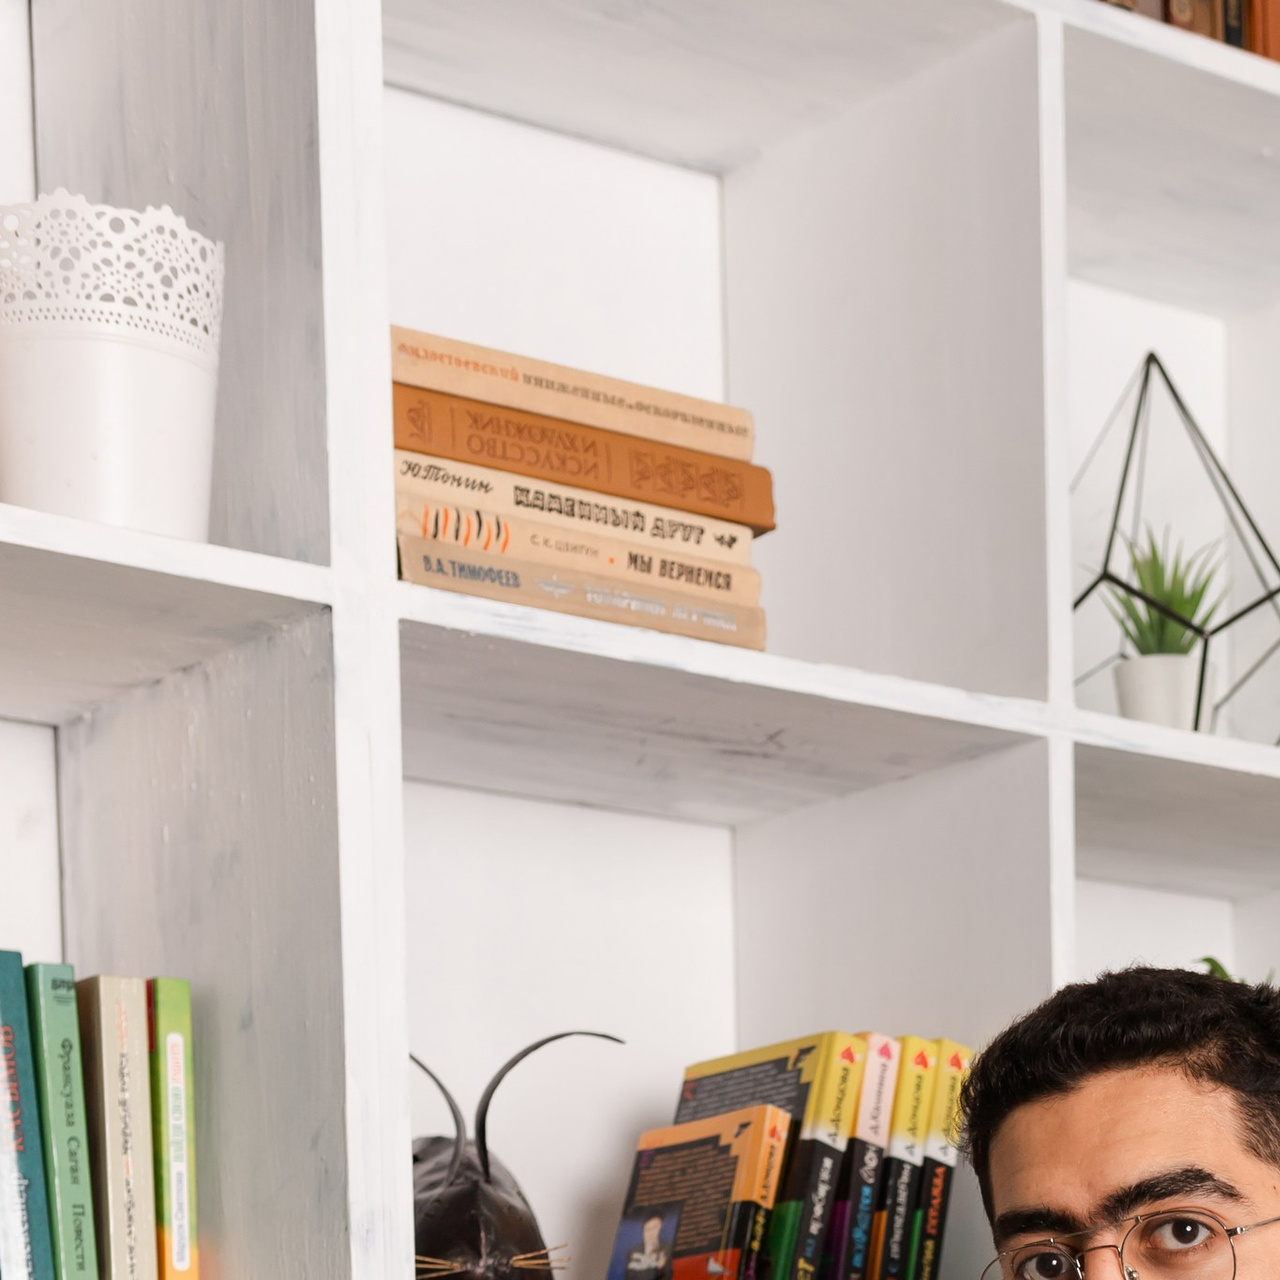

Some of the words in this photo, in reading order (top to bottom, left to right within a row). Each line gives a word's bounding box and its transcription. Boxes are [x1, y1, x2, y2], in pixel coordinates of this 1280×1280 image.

[464, 432, 599, 480] ИСКУССТВО
[625, 551, 653, 574] МЫ
[658, 558, 735, 591] ВЕРНЕМСЯ
[58, 1038, 79, 1127] Франсуаза
[65, 1136, 83, 1185] Саган
[70, 1202, 89, 1271] Повести
